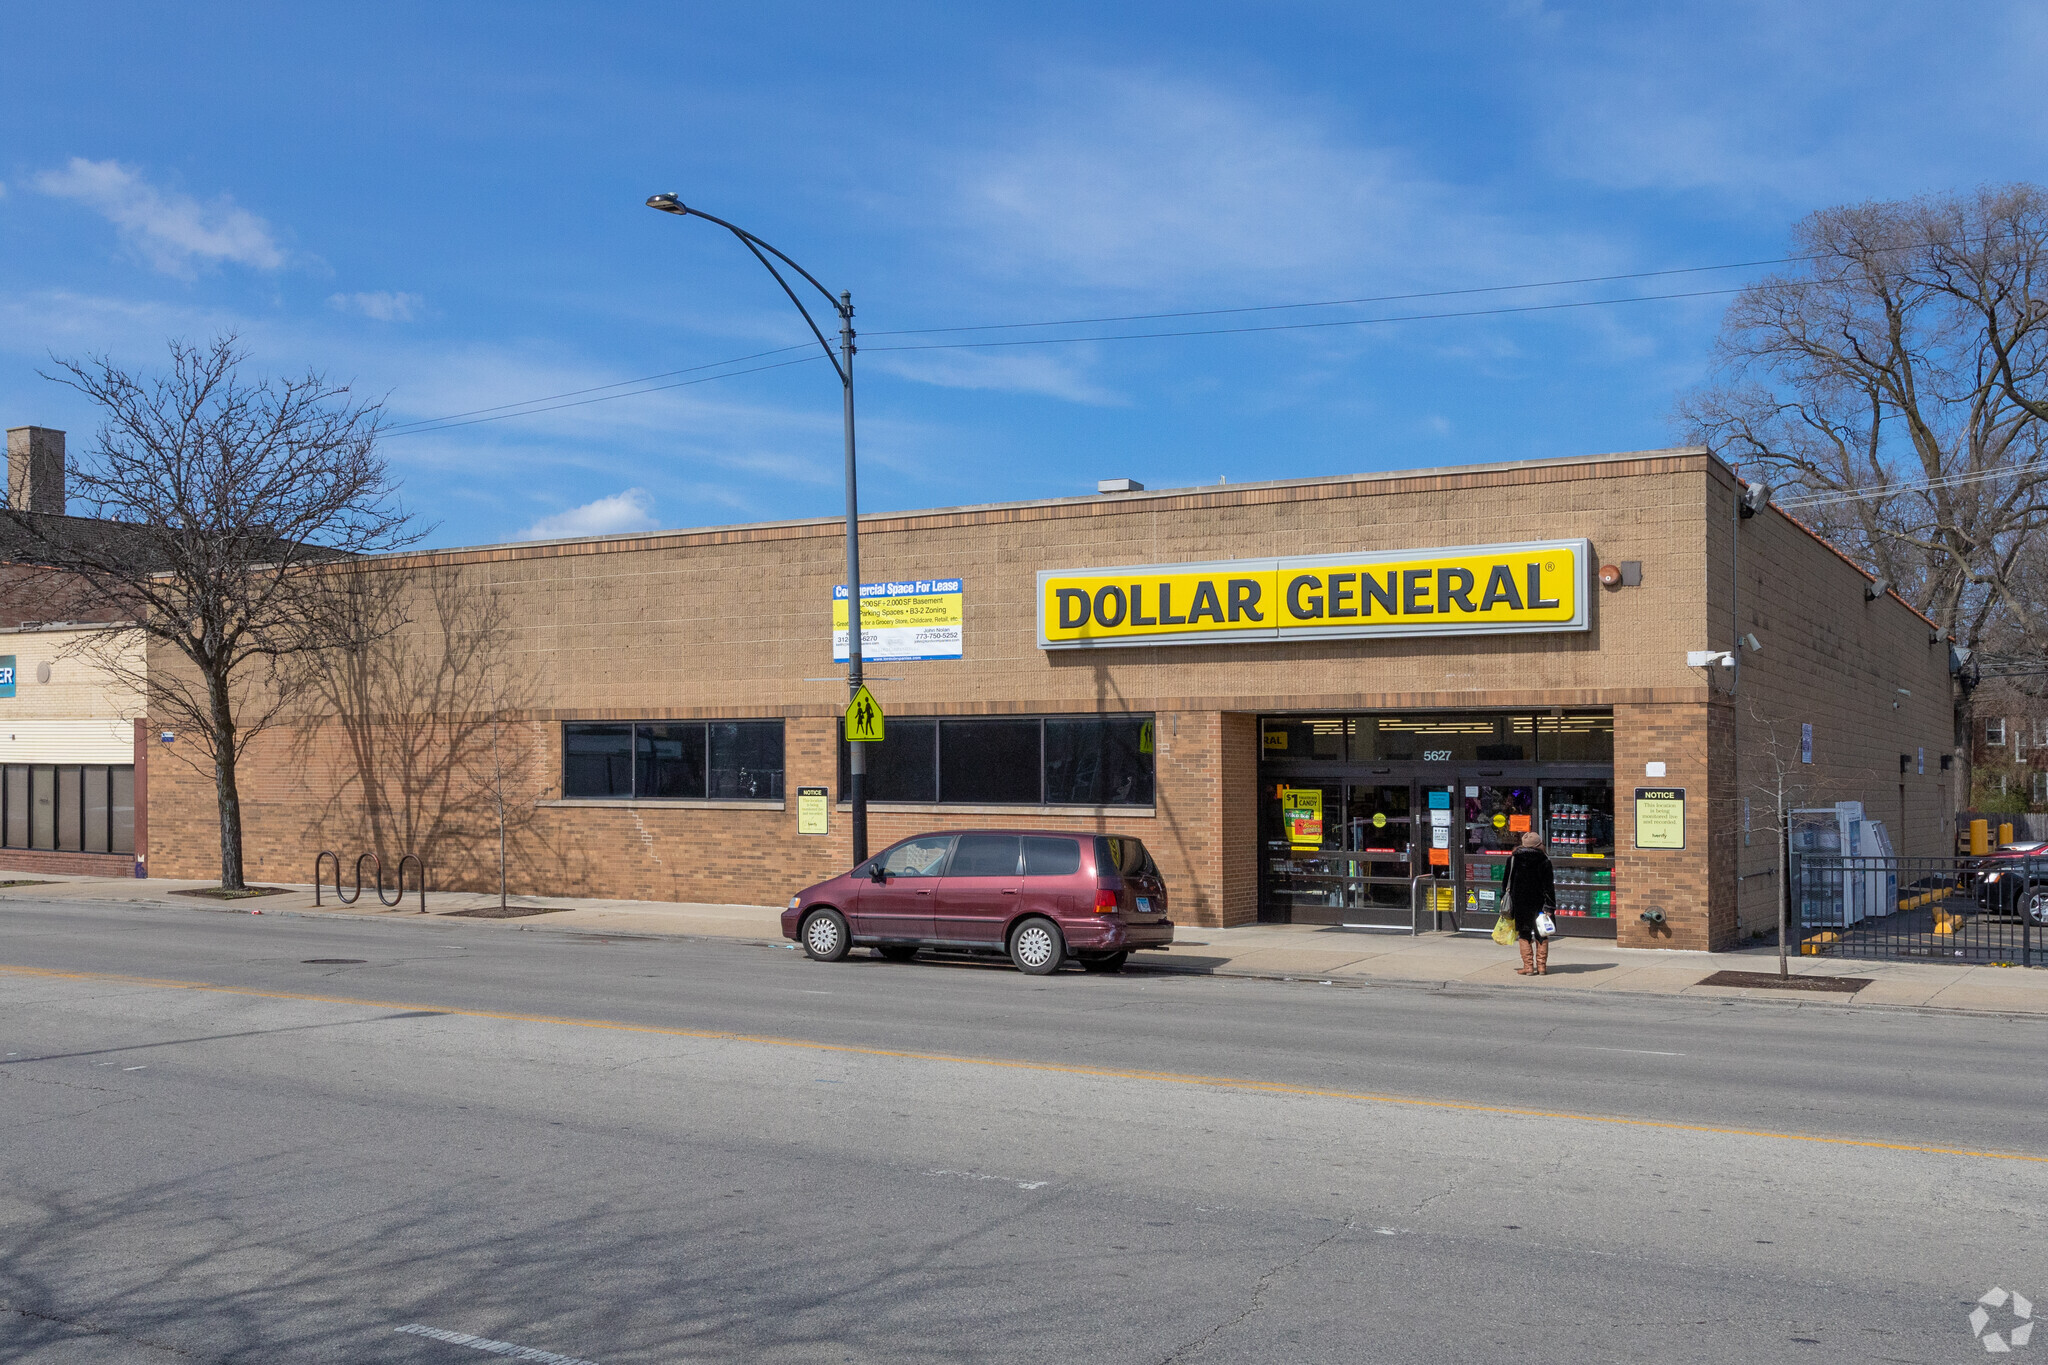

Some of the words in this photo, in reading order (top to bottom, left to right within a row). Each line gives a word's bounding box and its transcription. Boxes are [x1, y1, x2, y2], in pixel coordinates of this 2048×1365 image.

[836, 583, 886, 598] Coercial
[887, 582, 914, 597] Space
[916, 581, 931, 593] For
[932, 580, 959, 592] Lease
[912, 597, 944, 605] Basement
[1056, 578, 1264, 629] DOLLAR
[1286, 562, 1560, 620] GENERAL
[881, 608, 904, 617] Spaces
[910, 607, 925, 615] B3-2
[925, 606, 947, 615] Zoning
[915, 632, 958, 640] 773-750-5252
[1423, 750, 1453, 761] 5627
[1299, 799, 1318, 807] CANDY
